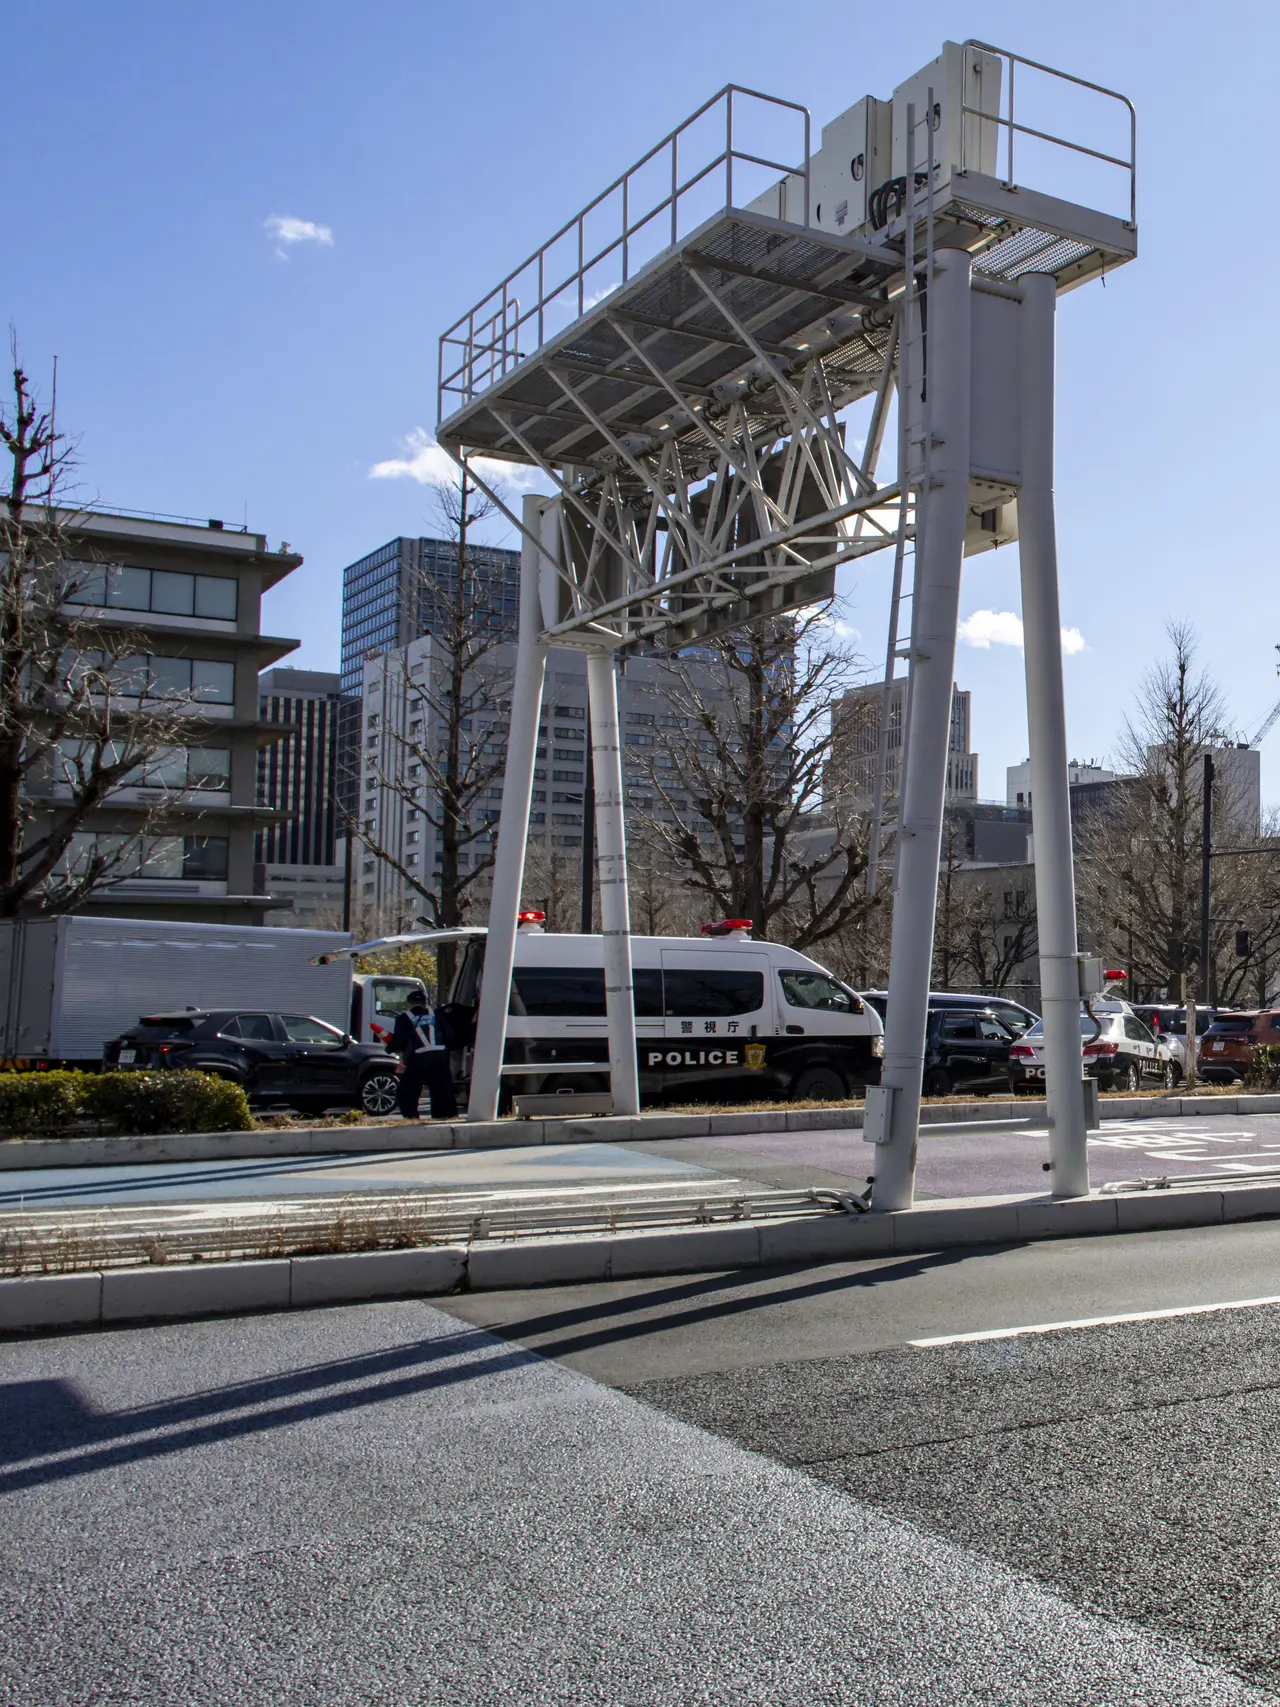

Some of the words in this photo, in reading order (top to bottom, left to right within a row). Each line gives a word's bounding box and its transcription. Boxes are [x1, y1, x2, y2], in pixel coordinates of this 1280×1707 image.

[681, 1020, 739, 1033] 警視庁
[648, 1051, 738, 1066] POLICE
[1139, 1059, 1158, 1072] POLICE
